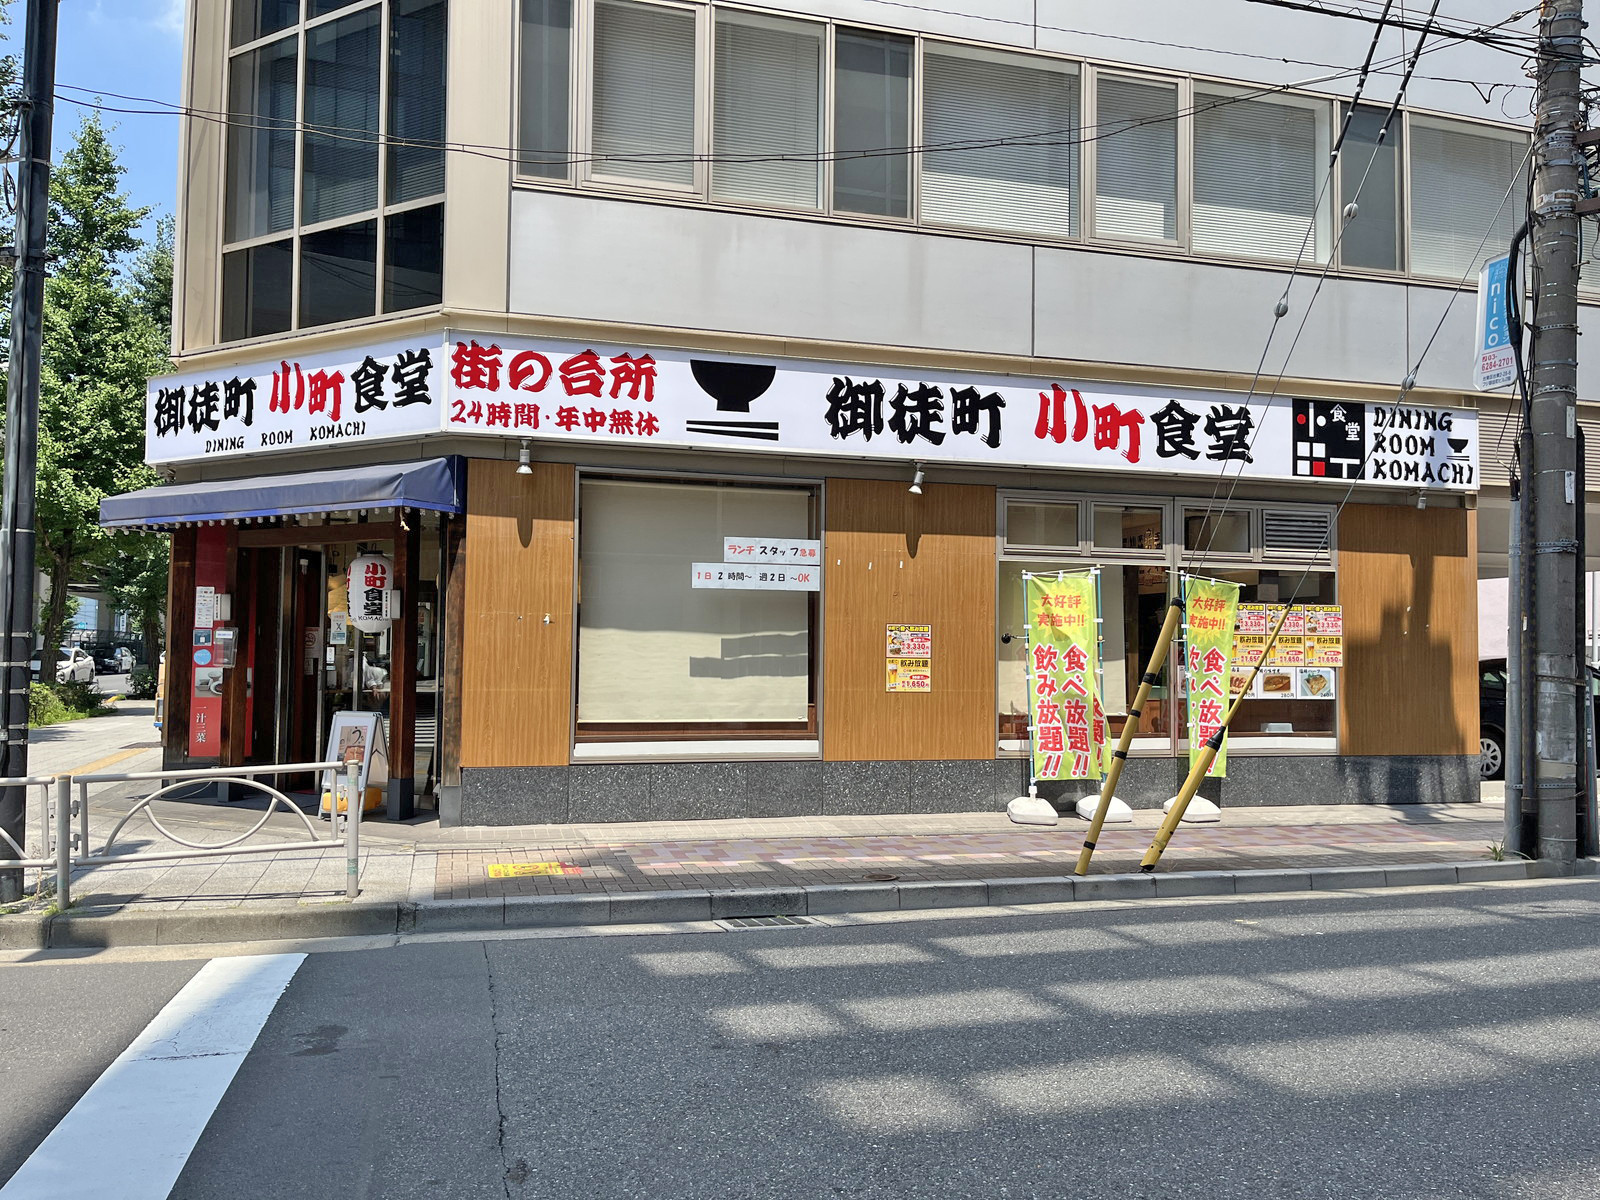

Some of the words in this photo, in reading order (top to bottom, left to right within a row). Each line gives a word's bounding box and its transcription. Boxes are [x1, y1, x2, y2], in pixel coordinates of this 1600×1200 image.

[1488, 282, 1501, 346] nico
[450, 339, 659, 403] 街の台所
[1482, 356, 1513, 372] 6284-2701
[154, 375, 257, 437] 御徒町
[269, 347, 433, 422] 小町食堂
[825, 376, 1006, 449] 御徒町
[1034, 382, 1256, 464] 小町食堂
[1373, 406, 1453, 432] DINING
[205, 435, 245, 454] DINING
[261, 429, 294, 448] ROOM
[310, 420, 367, 441] KOMACHI
[1373, 432, 1435, 457] ROOM
[1373, 458, 1474, 485] KOMACHI
[364, 562, 387, 616] 小町食堂
[1040, 594, 1082, 609] 大好評
[1192, 598, 1226, 612] 大好評
